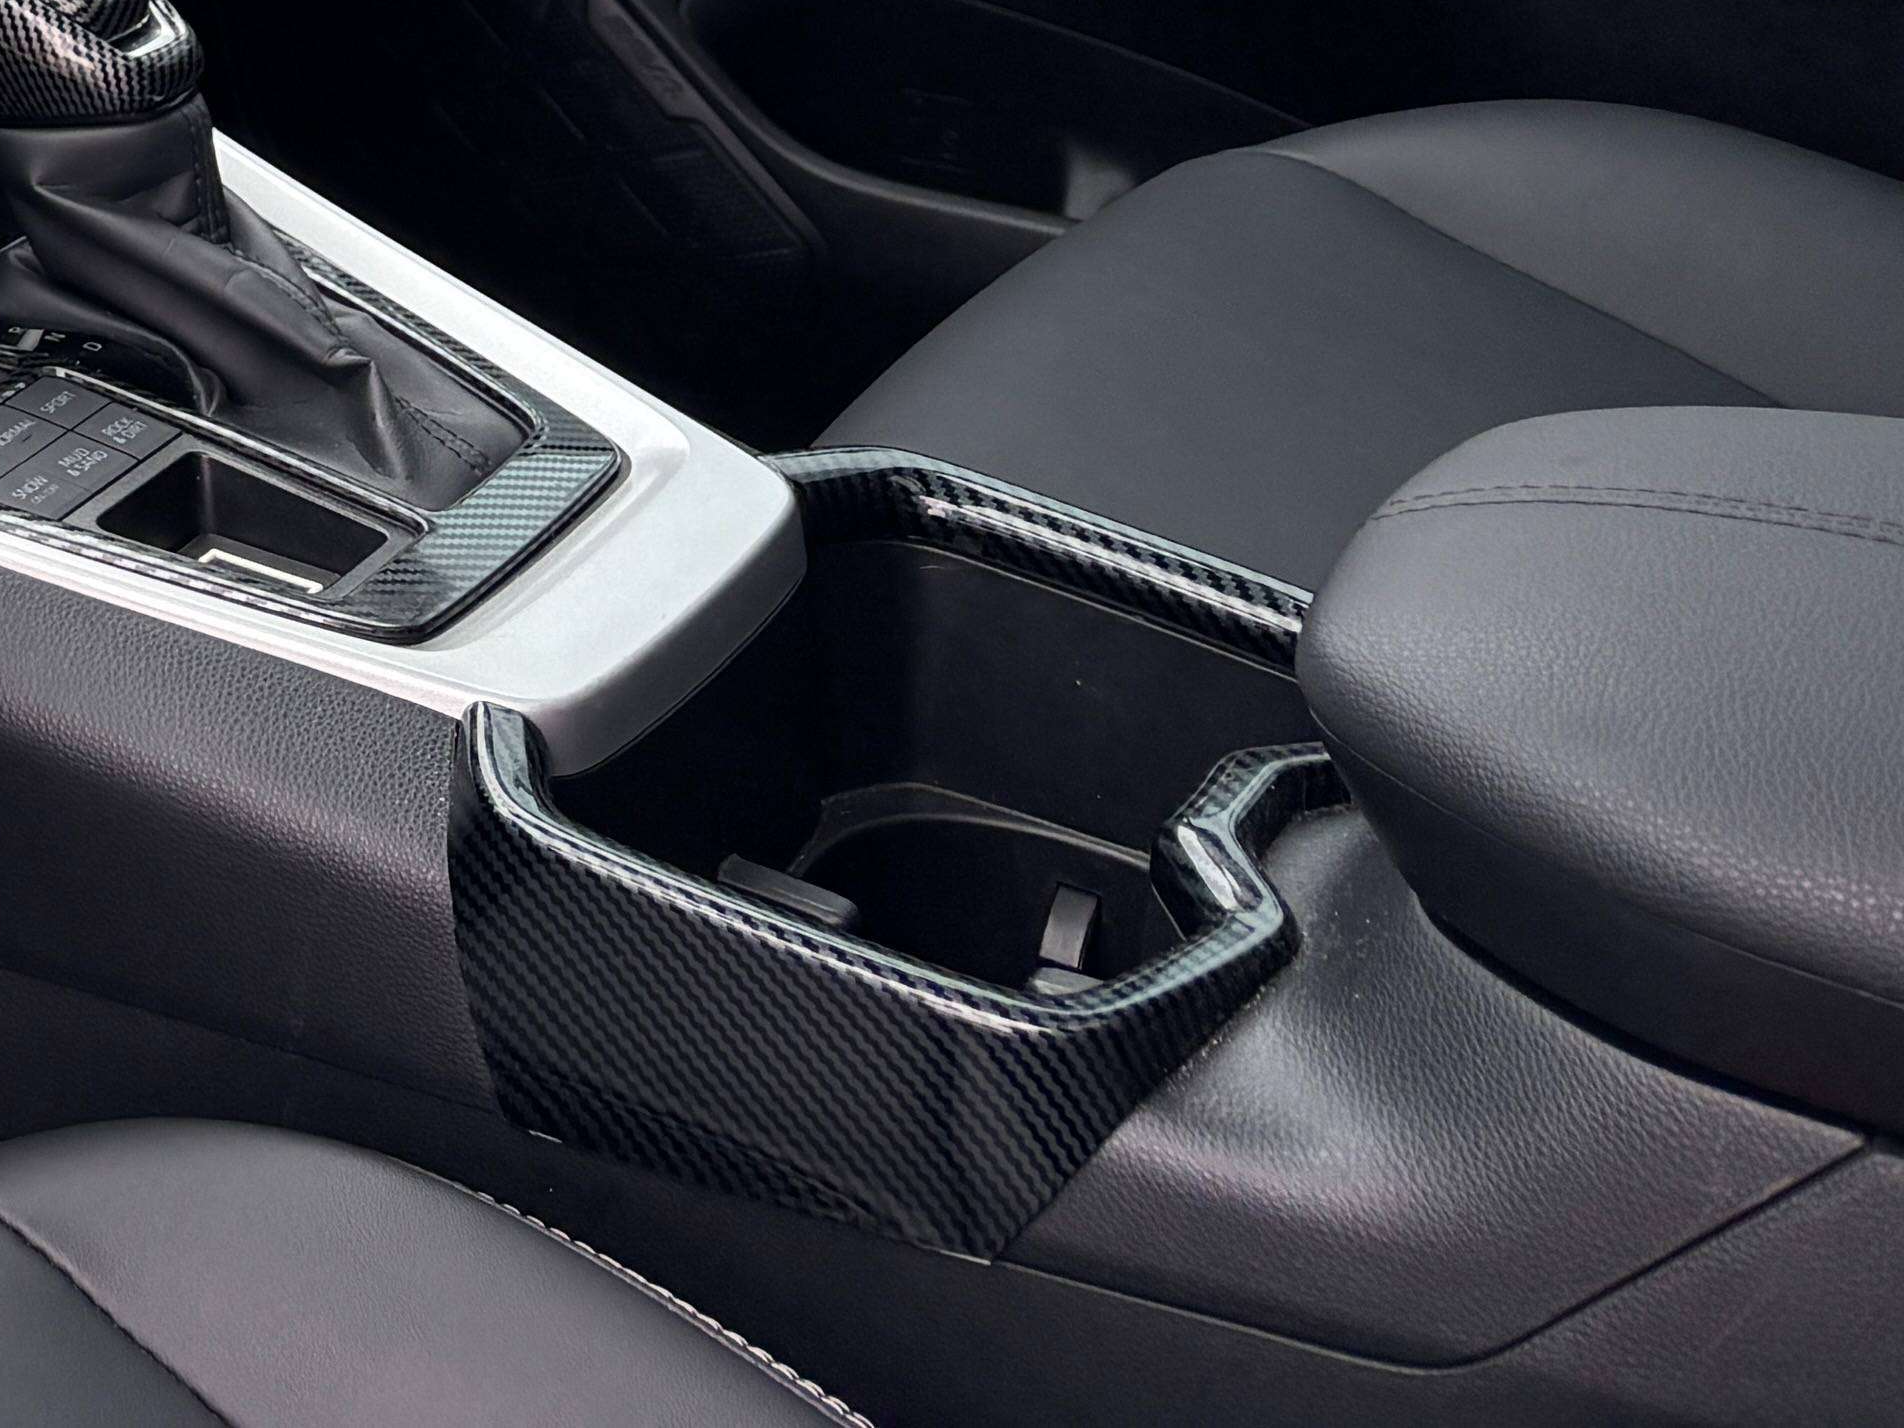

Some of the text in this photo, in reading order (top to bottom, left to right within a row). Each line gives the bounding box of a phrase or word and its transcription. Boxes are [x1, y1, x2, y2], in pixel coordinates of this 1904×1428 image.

[39, 390, 79, 415] SPORT
[57, 447, 91, 469] MUD
[11, 474, 51, 500] SNOW
